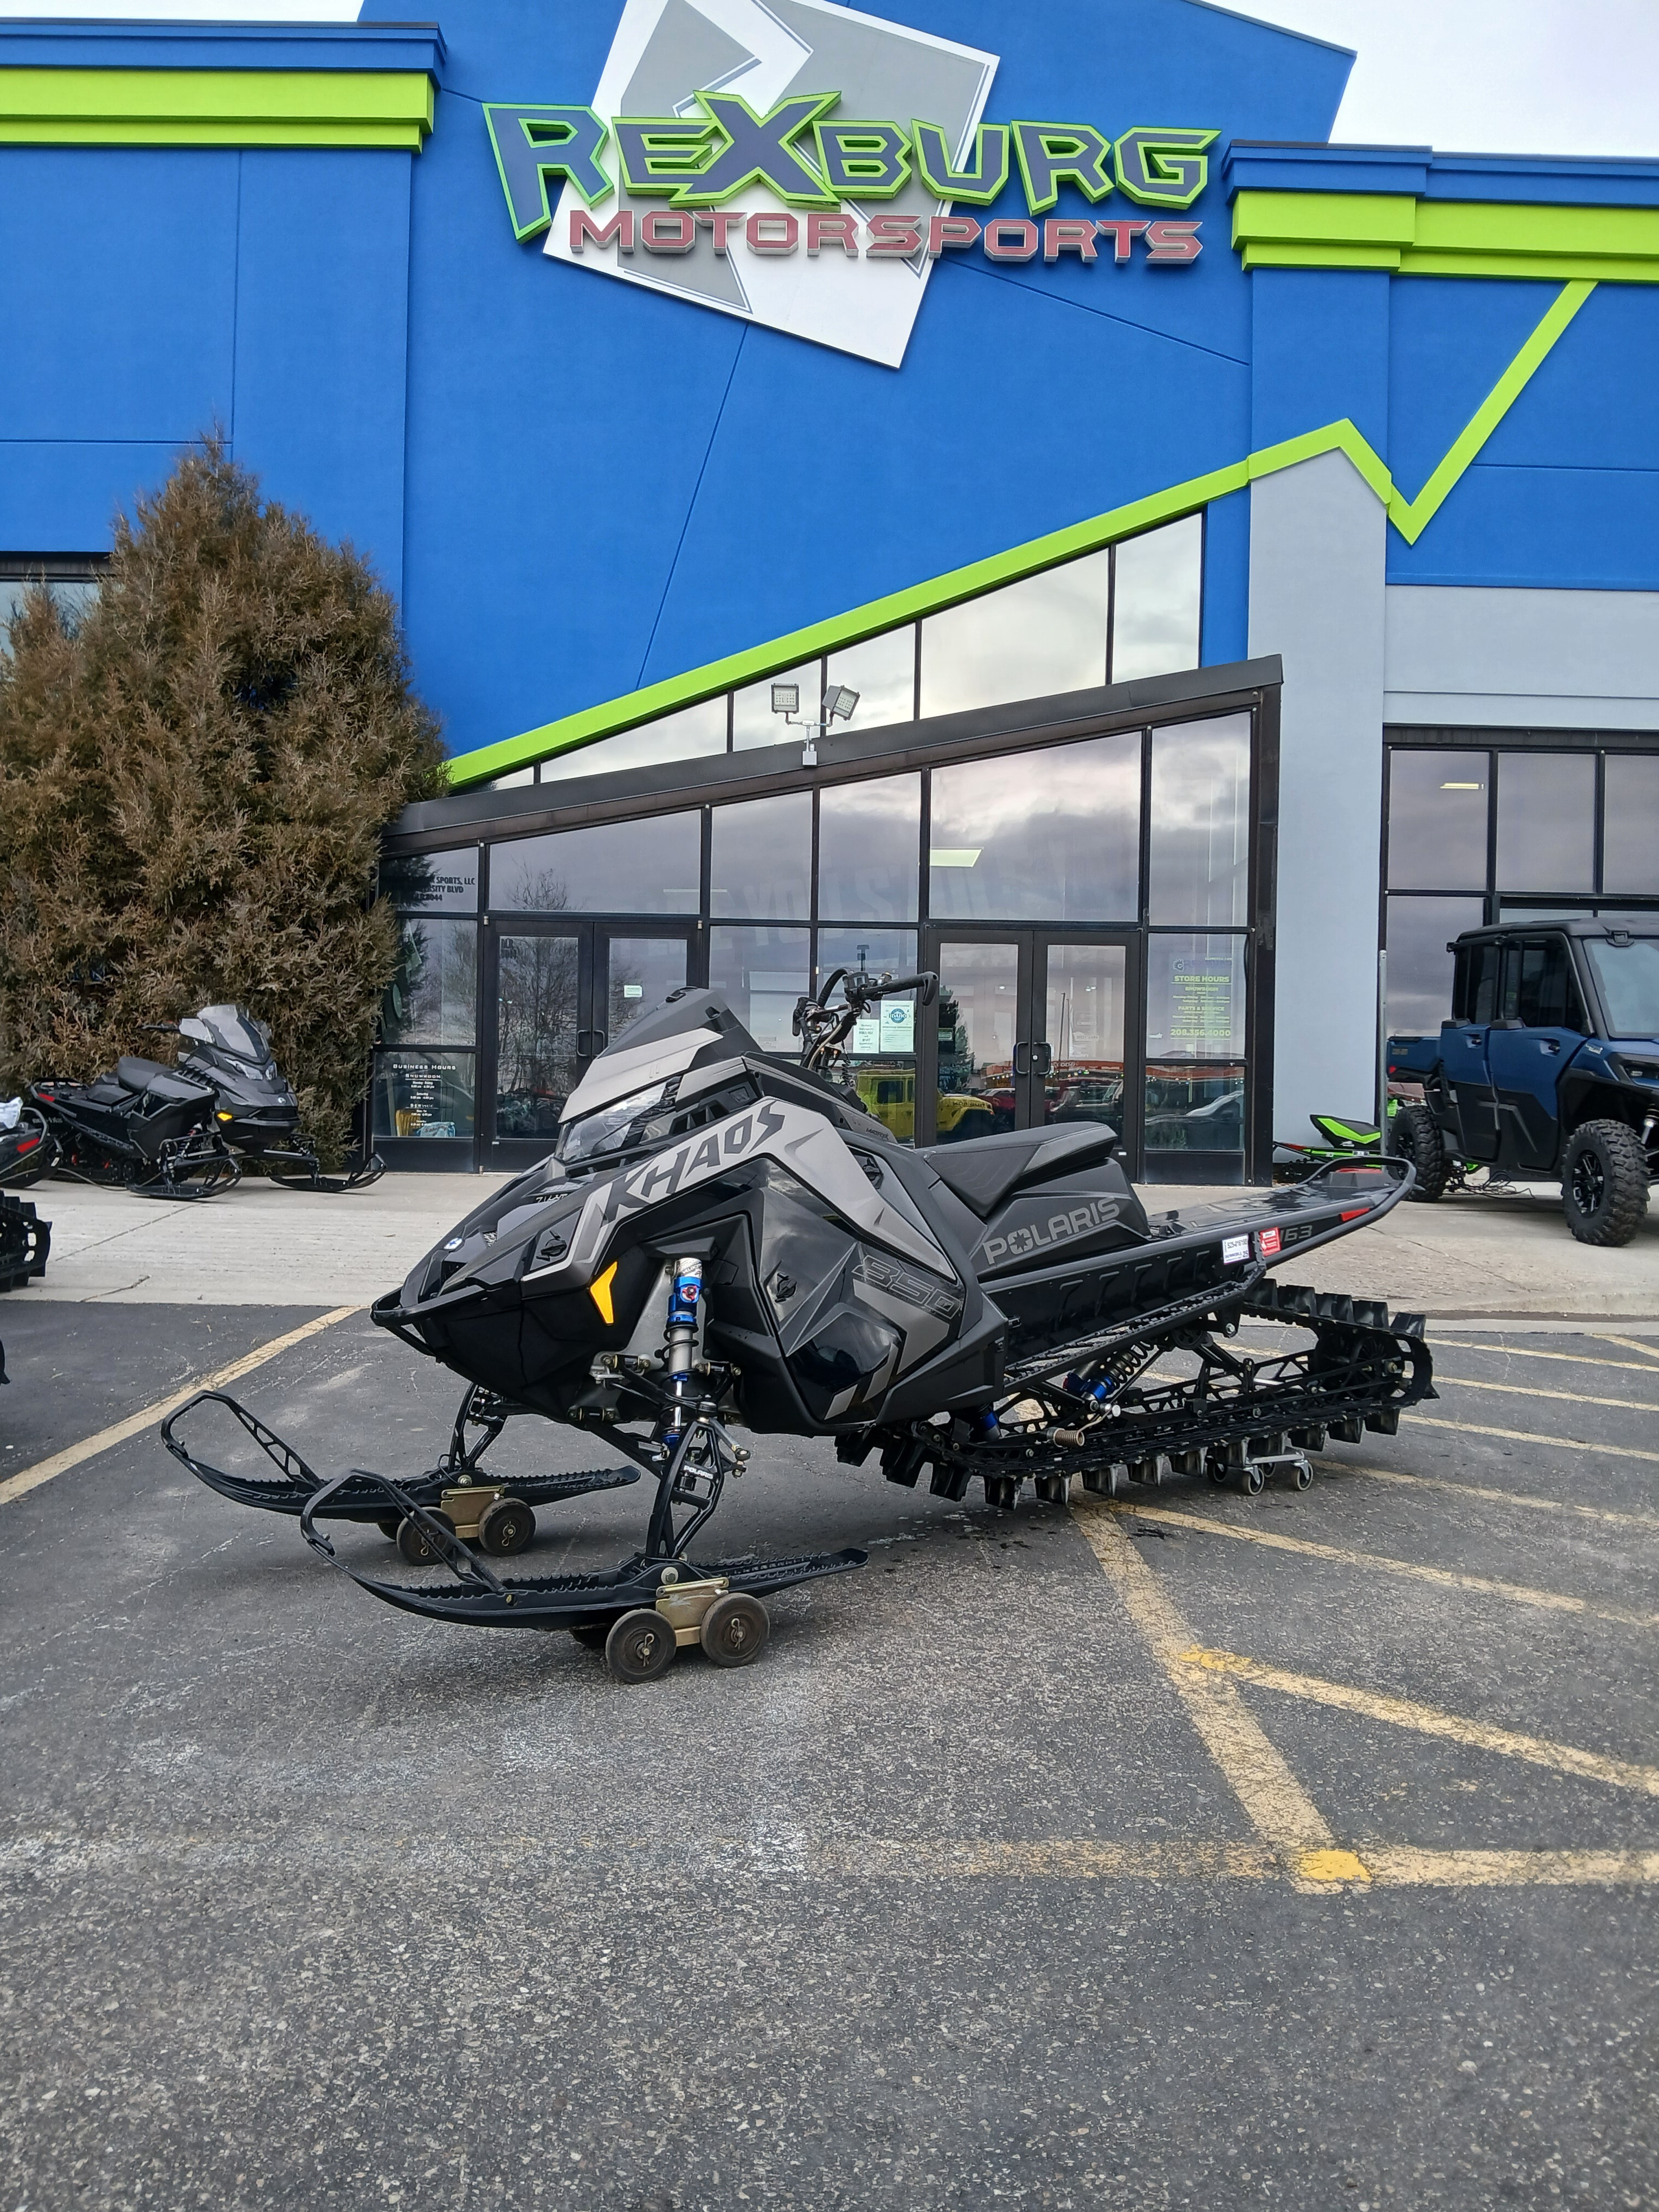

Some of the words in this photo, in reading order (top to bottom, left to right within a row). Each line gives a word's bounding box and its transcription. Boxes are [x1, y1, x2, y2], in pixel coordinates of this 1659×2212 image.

[483, 90, 1221, 241] REXBURG
[569, 210, 1203, 265] MOTORSPORTS
[436, 876, 462, 885] SPORTS,
[447, 885, 464, 893] BLVD
[1170, 1028, 1231, 1037] 208.356.4000
[600, 1100, 786, 1229] KHAOS
[982, 1197, 1120, 1265] POLARIS
[1280, 1225, 1313, 1243] 163
[851, 1255, 962, 1320] 850
